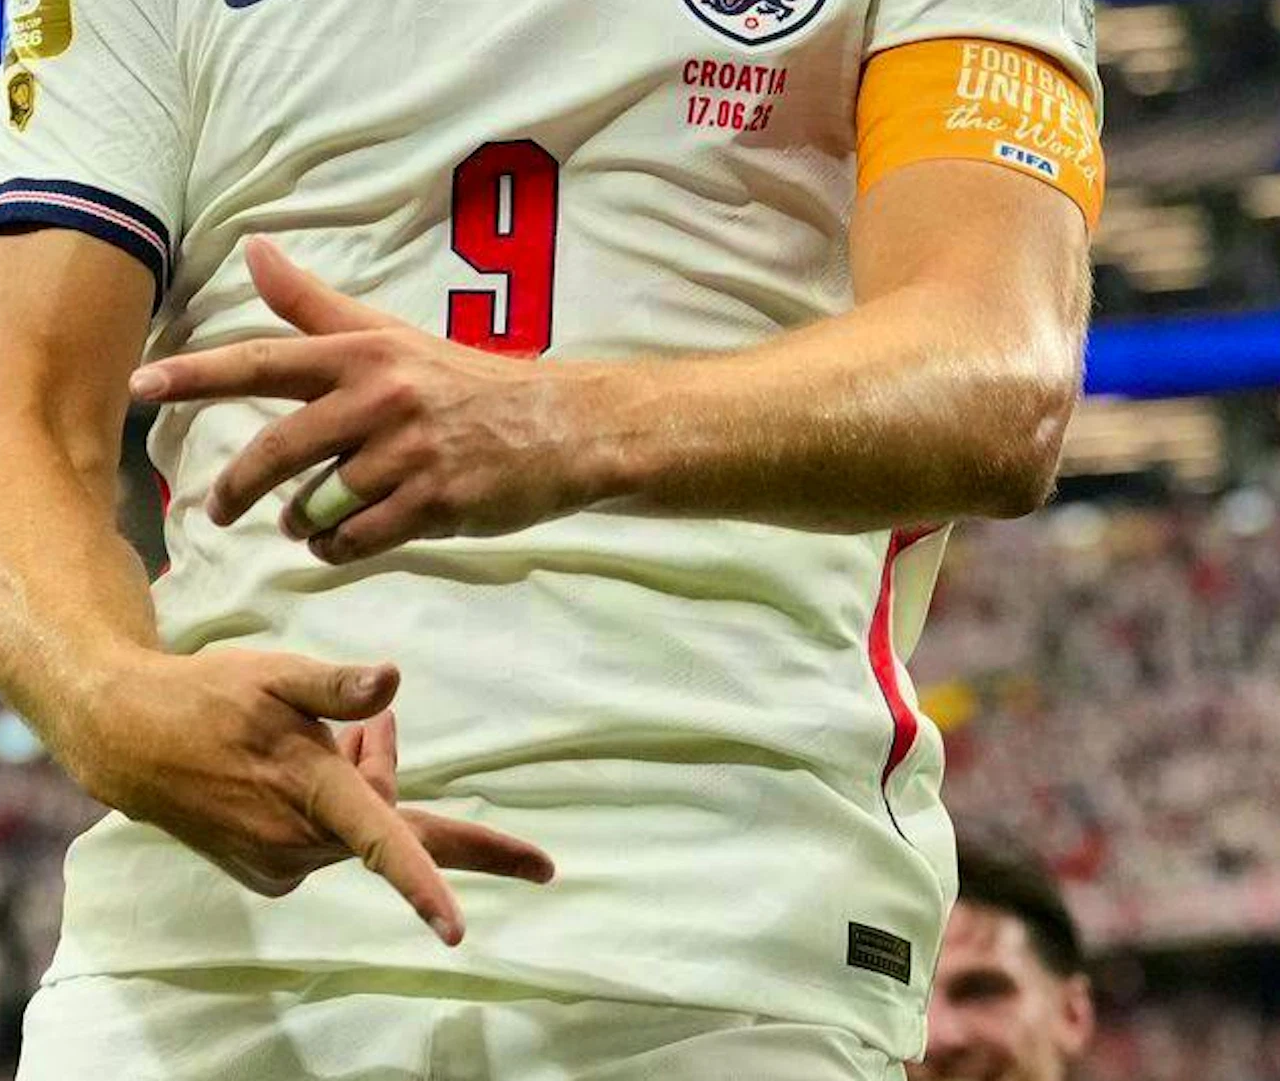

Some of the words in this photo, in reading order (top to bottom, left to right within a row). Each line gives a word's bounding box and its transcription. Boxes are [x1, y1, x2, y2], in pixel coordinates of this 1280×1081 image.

[683, 59, 787, 95] CROATIA
[944, 101, 1007, 132] the
[999, 144, 1054, 175] FIFA
[446, 139, 560, 361] 9
